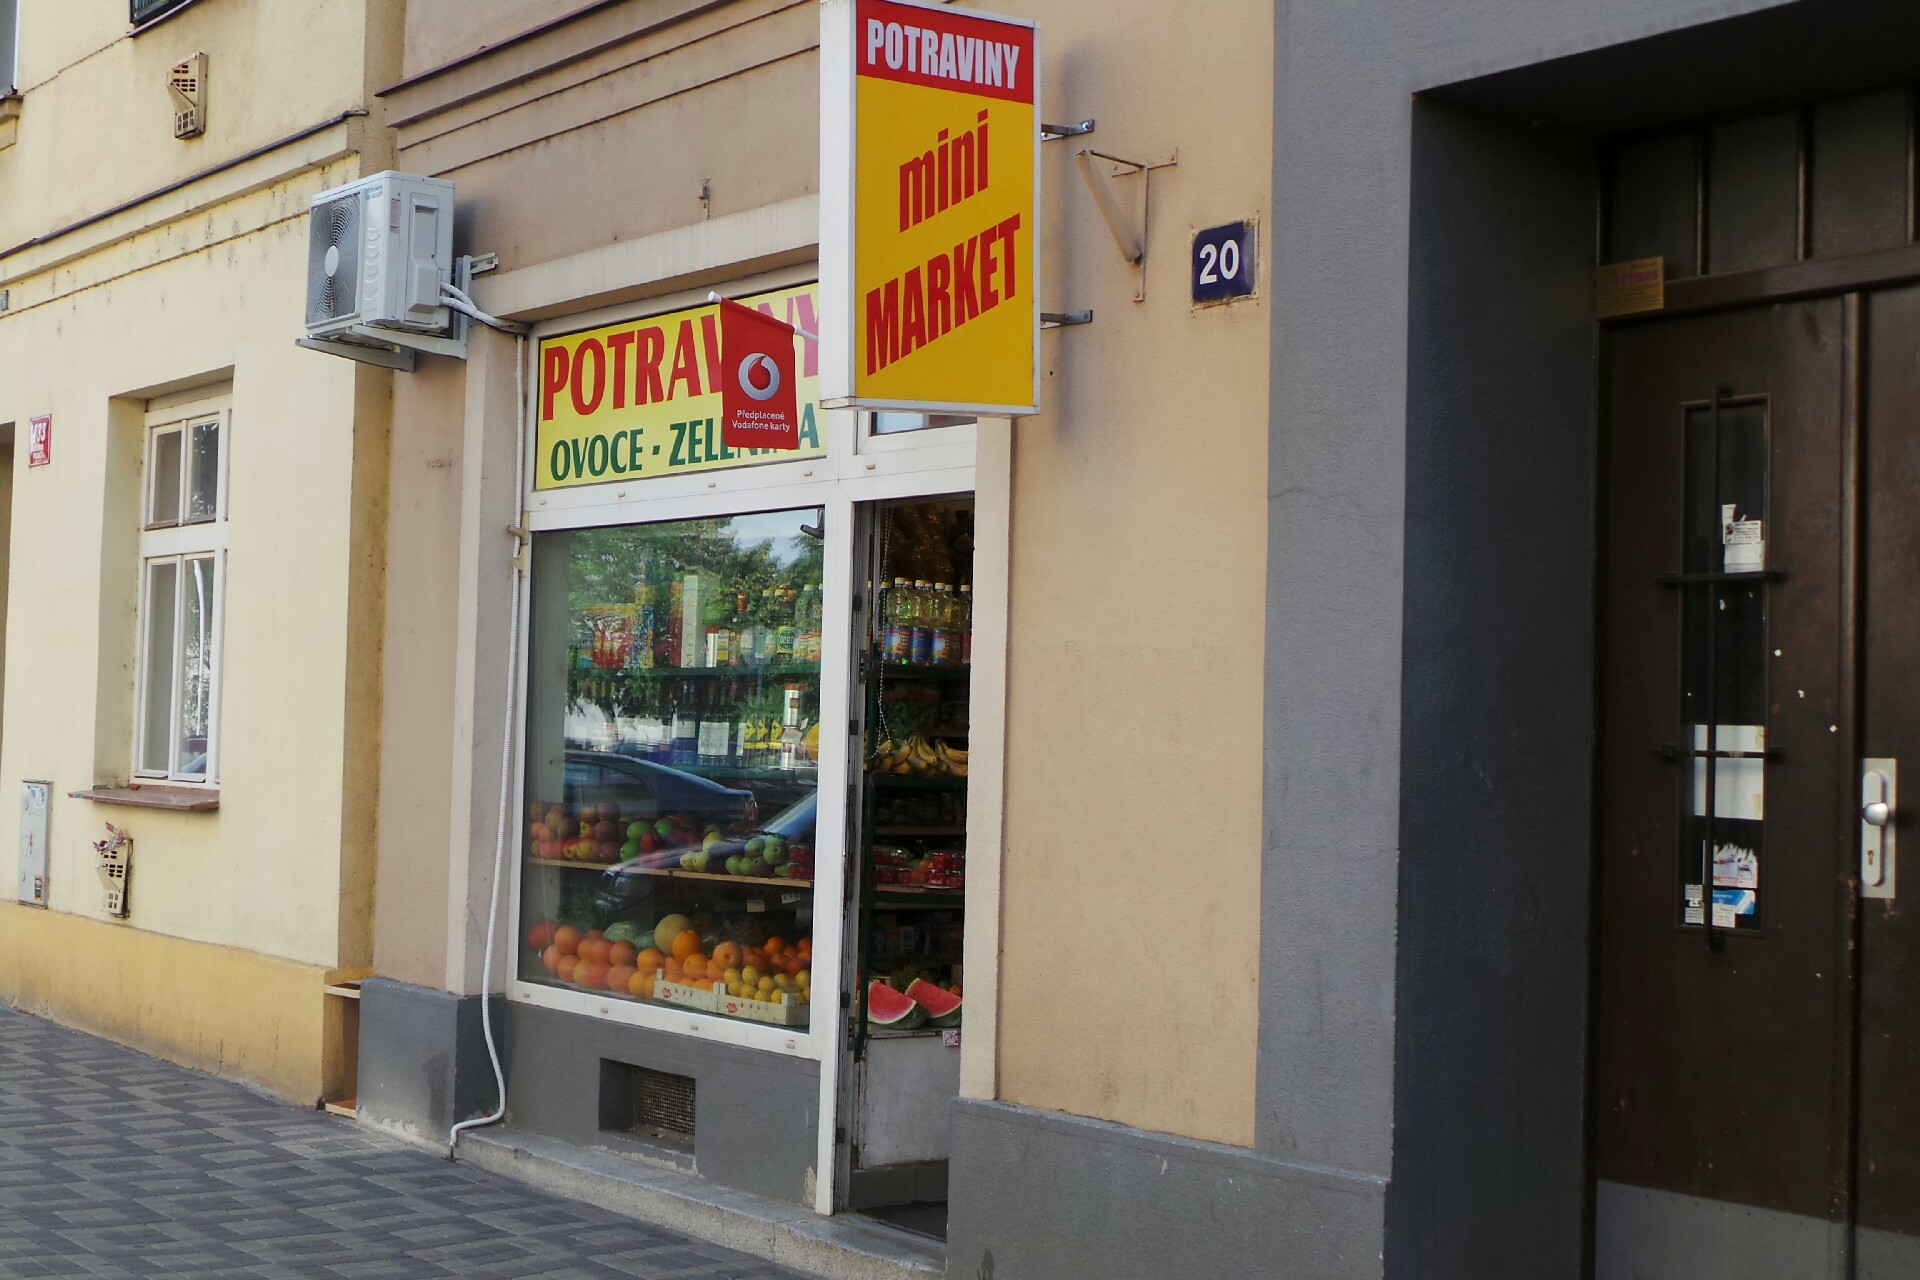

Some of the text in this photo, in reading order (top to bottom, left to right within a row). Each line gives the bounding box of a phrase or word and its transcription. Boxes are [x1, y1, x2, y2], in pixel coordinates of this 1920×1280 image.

[867, 18, 1020, 90] POTRAVINY
[899, 108, 988, 233] mini
[866, 212, 1020, 377] MARKET
[1199, 239, 1240, 285] 20
[543, 293, 818, 421] POTRAVY
[550, 428, 644, 481] OVOCE
[668, 402, 820, 467] ZELA
[731, 420, 791, 433] Vodafone karty
[736, 409, 785, 421] Předplacené
